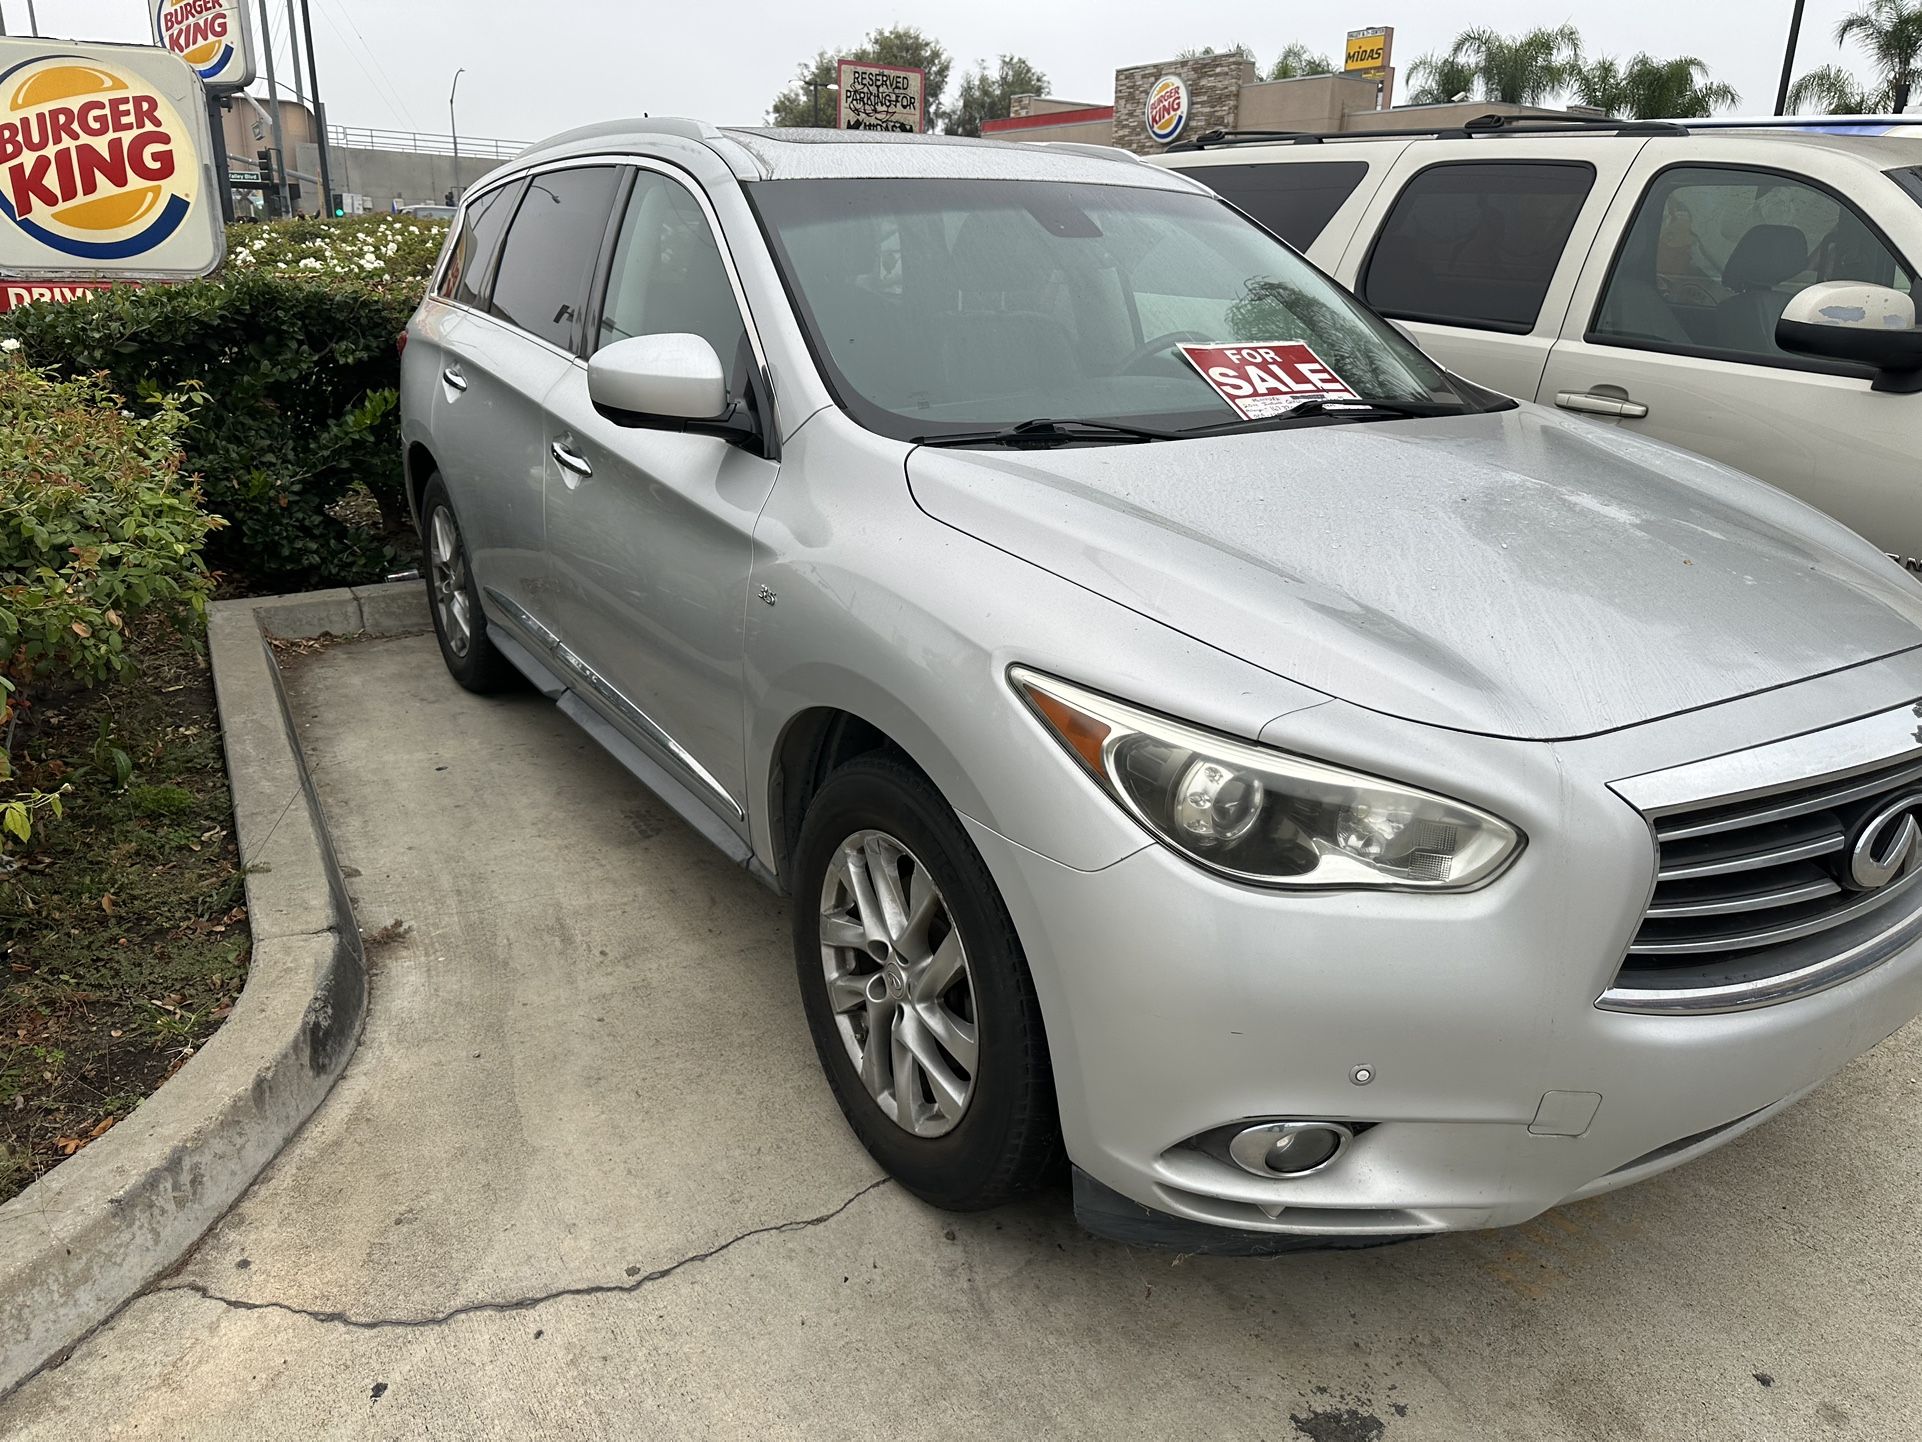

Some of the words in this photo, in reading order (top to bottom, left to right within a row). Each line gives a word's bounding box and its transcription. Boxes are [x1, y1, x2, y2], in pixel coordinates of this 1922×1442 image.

[168, 12, 228, 53] KING
[1345, 45, 1384, 64] MIDAS
[853, 71, 909, 90] RESERVED
[845, 89, 891, 108] PARKING
[893, 95, 916, 111] FOR
[1150, 86, 1180, 114] BURGER
[1151, 96, 1181, 129] KING
[0, 95, 162, 164] BURGER
[9, 131, 175, 218] KING
[1223, 348, 1283, 364] FOR
[1208, 362, 1345, 396] SALE
